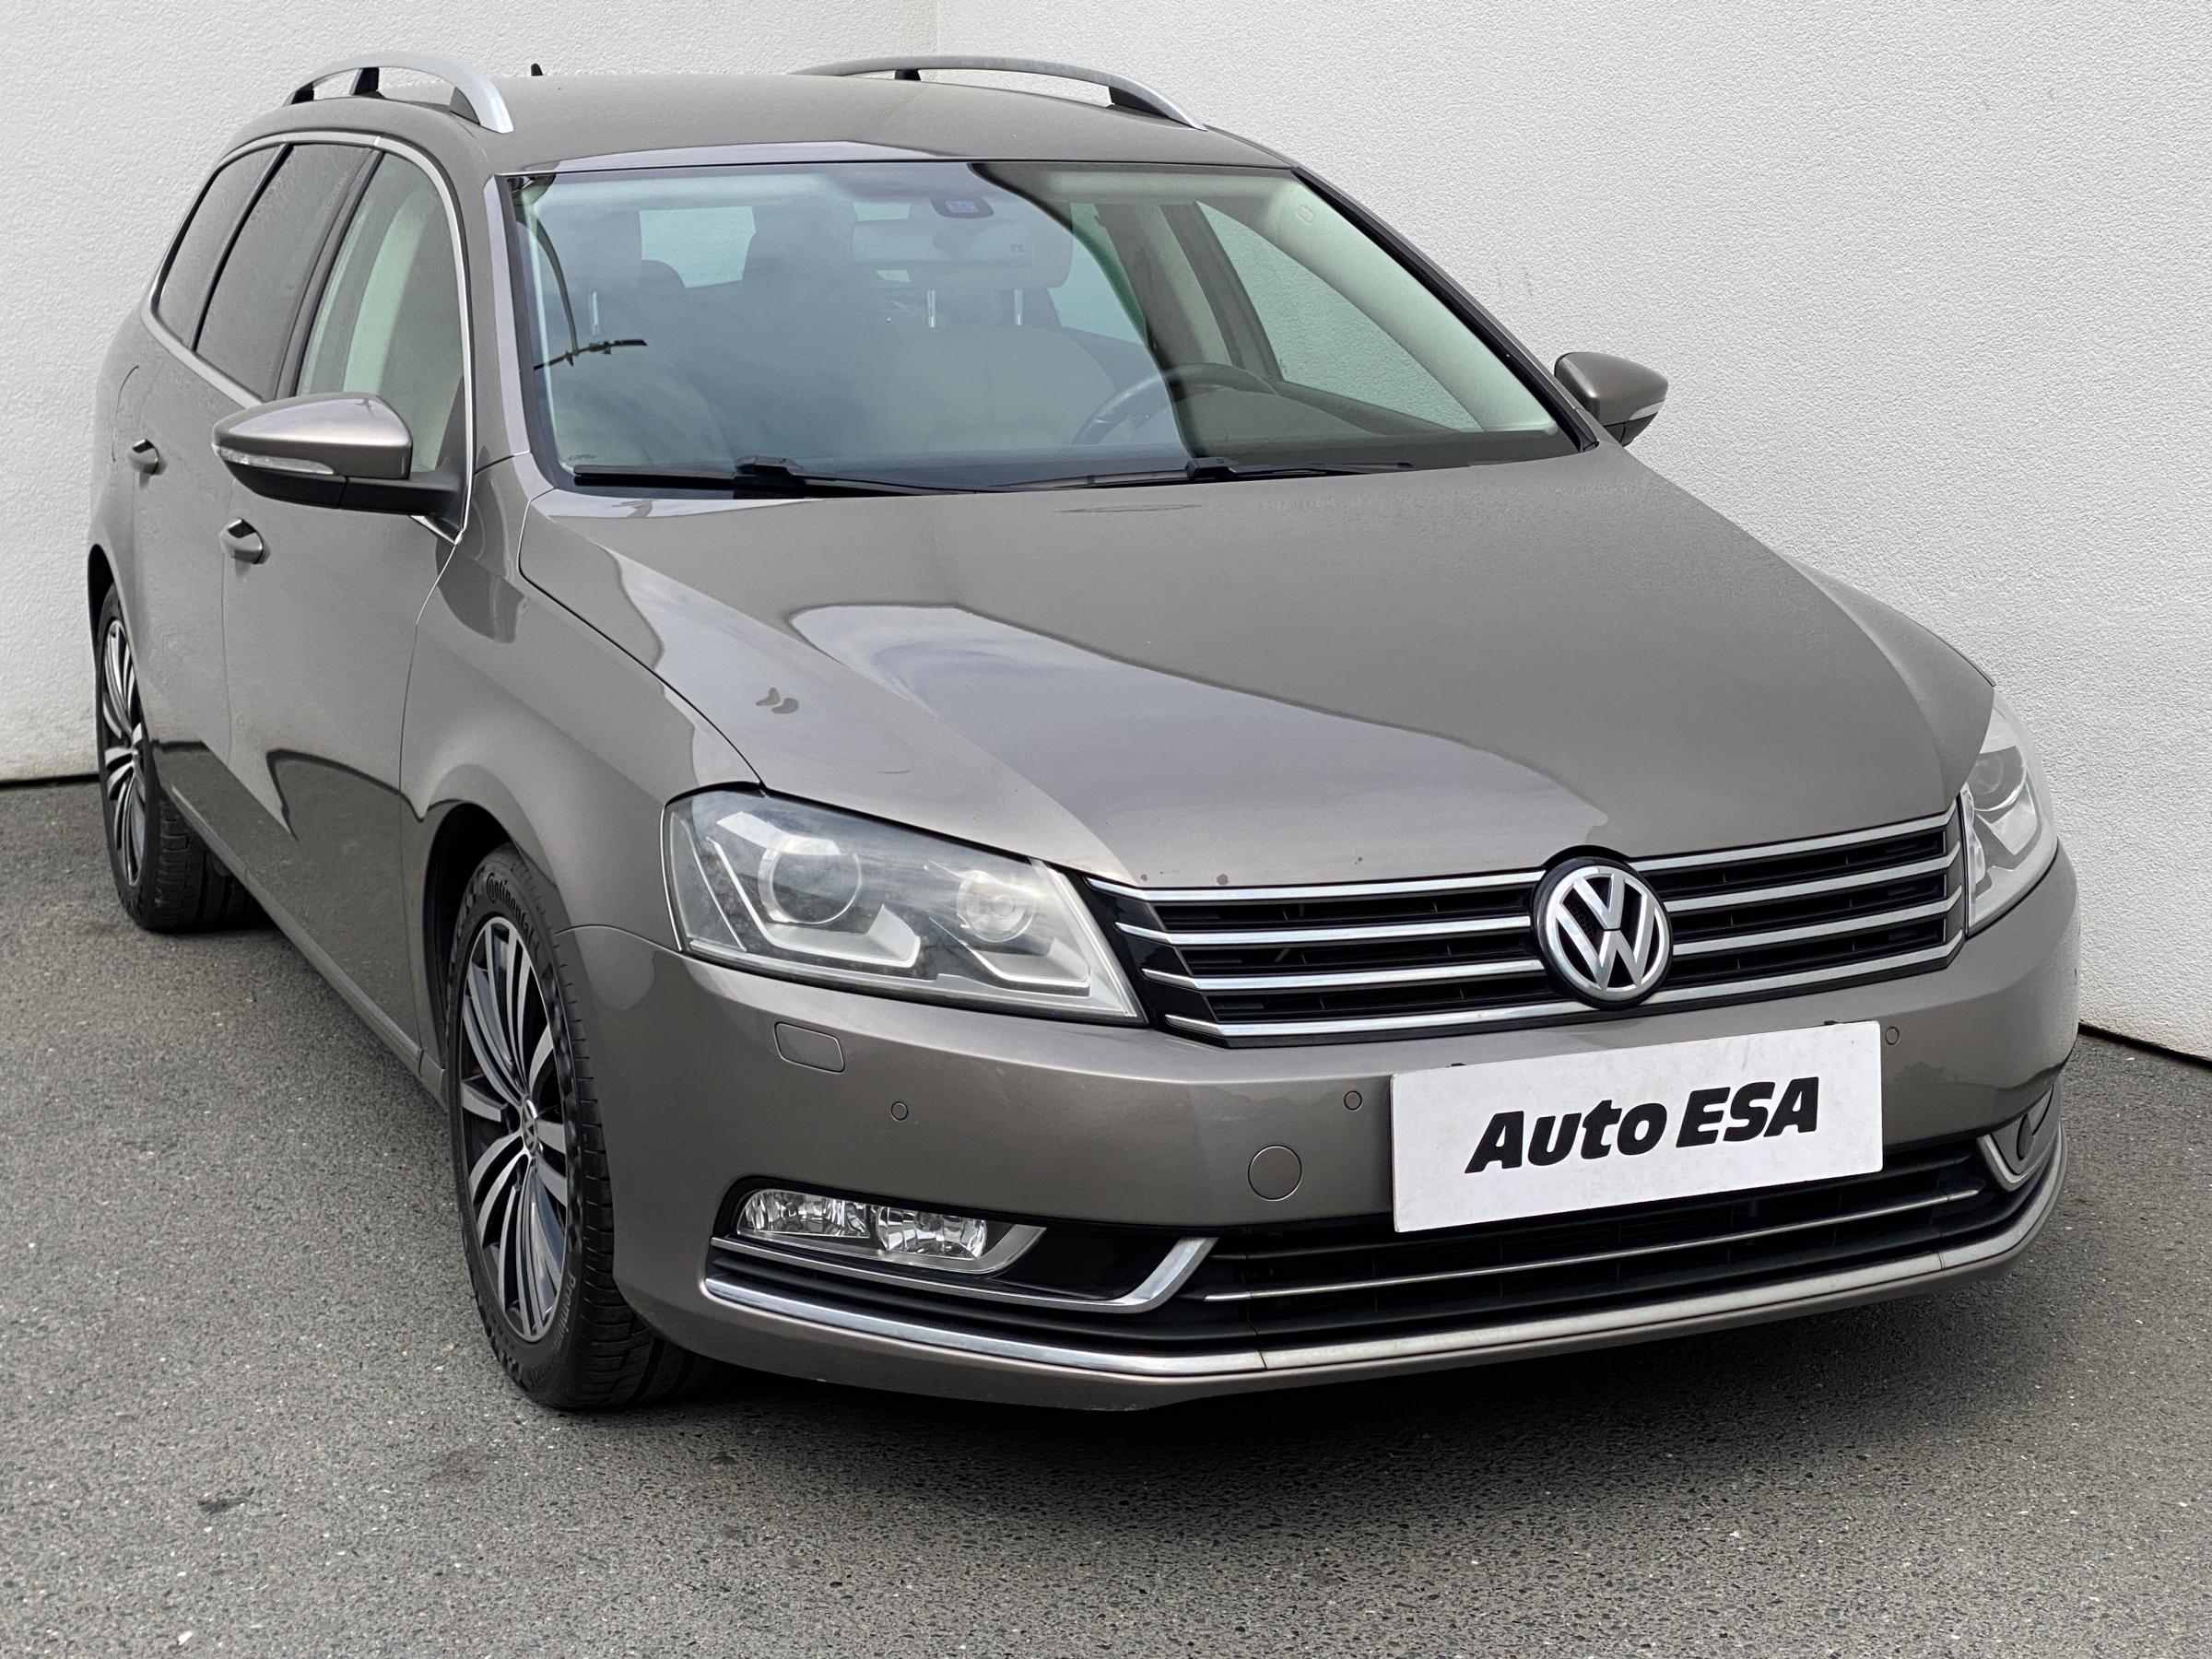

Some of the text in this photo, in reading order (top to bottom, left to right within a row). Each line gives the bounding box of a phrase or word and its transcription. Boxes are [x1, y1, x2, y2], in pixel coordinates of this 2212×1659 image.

[487, 873, 535, 947] Continental
[1464, 1077, 1819, 1173] Auto ESA
